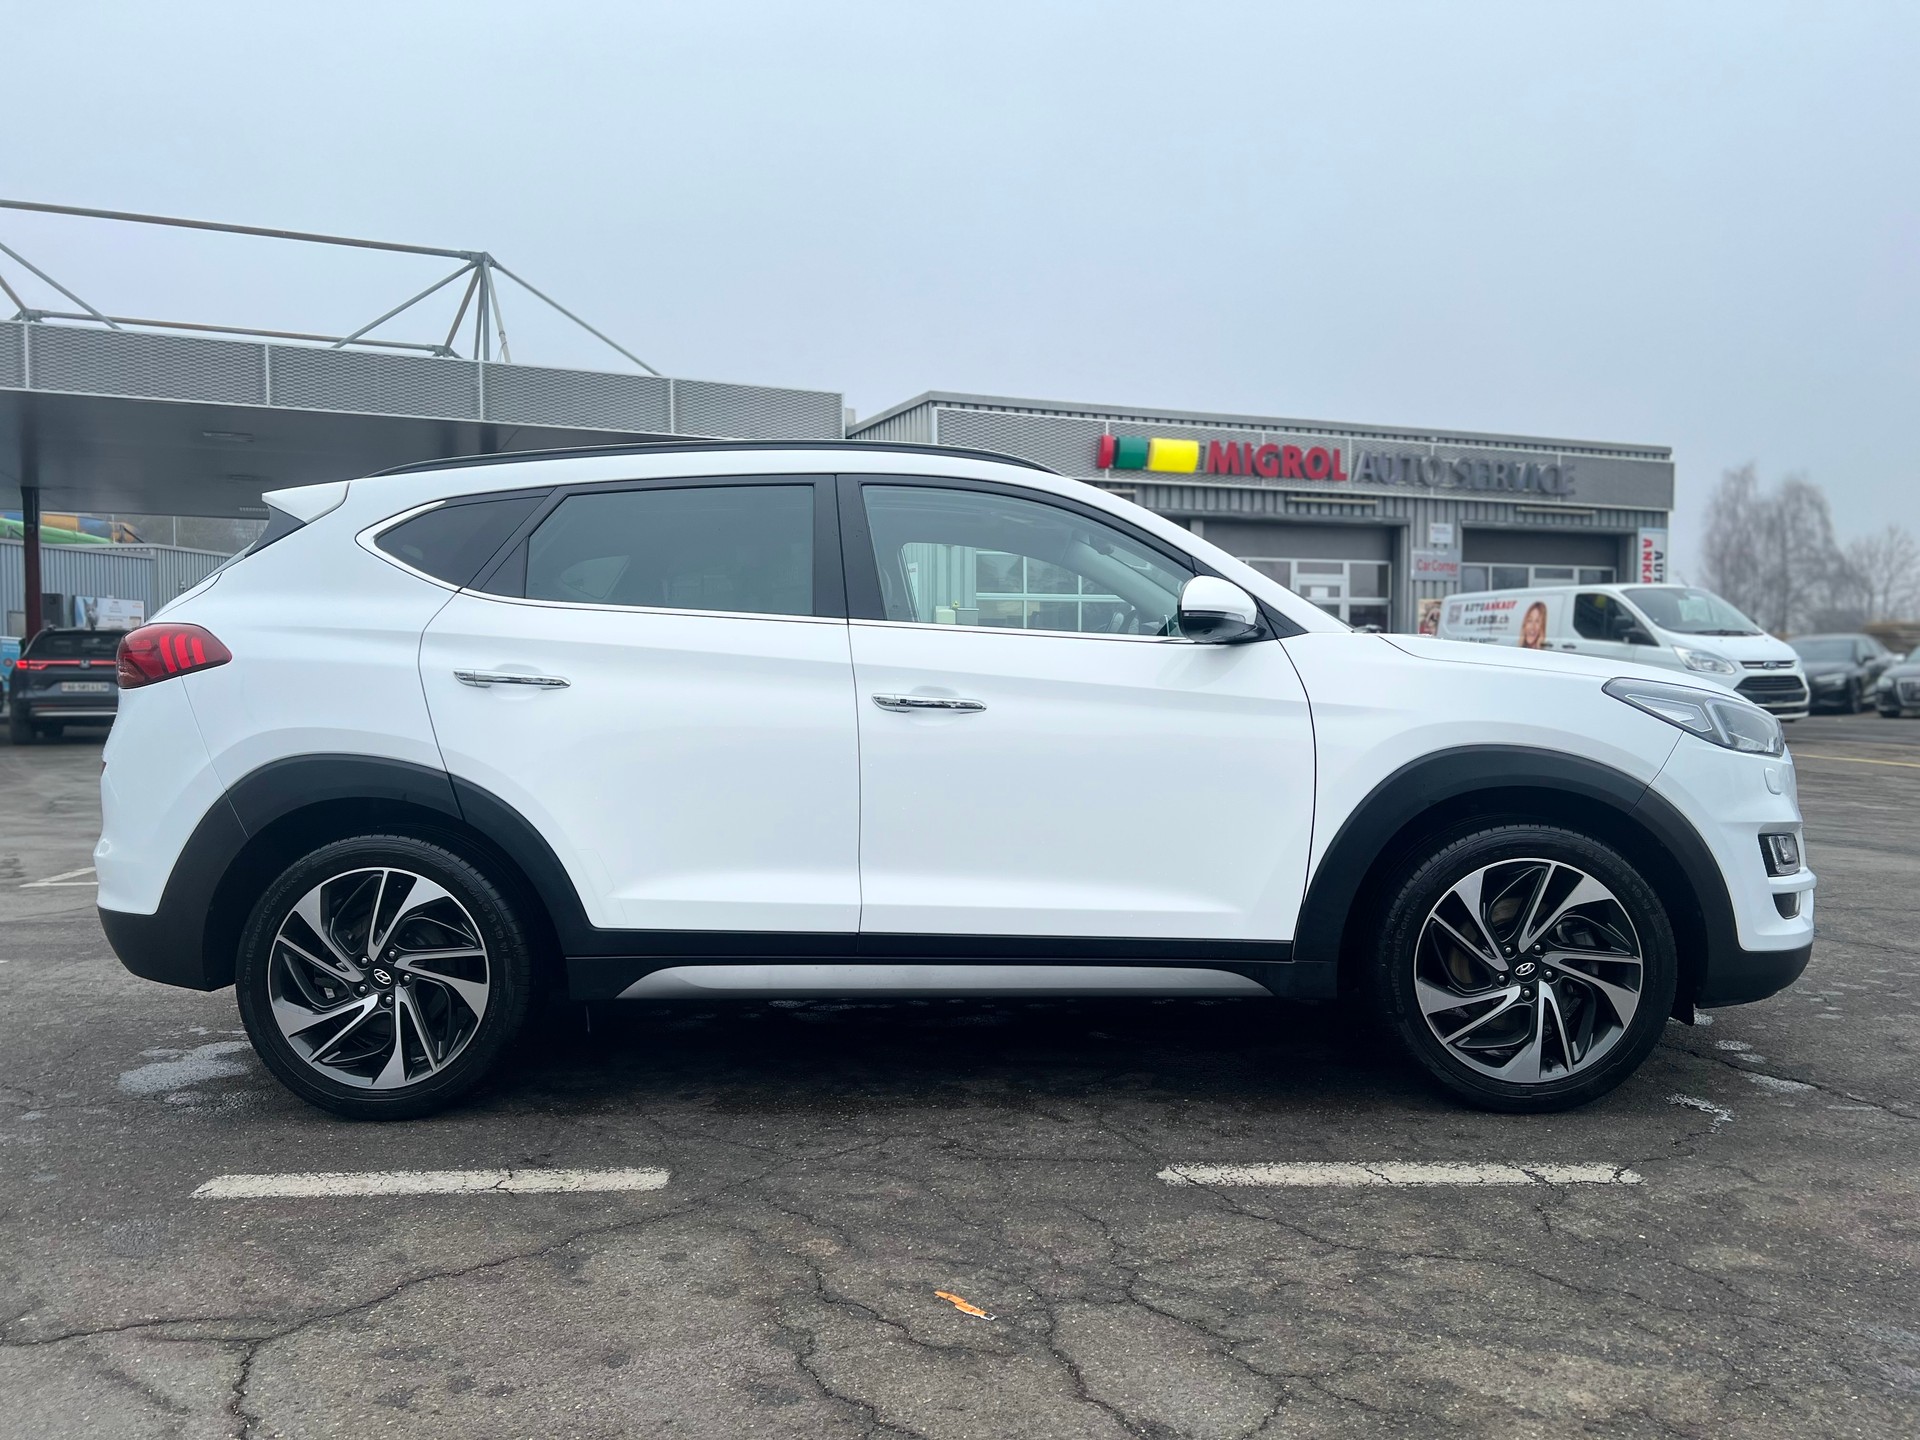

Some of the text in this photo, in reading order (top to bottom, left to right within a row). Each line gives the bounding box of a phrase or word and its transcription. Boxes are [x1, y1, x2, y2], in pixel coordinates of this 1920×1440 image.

[1206, 440, 1576, 496] MIGROL AUTO SERVICE
